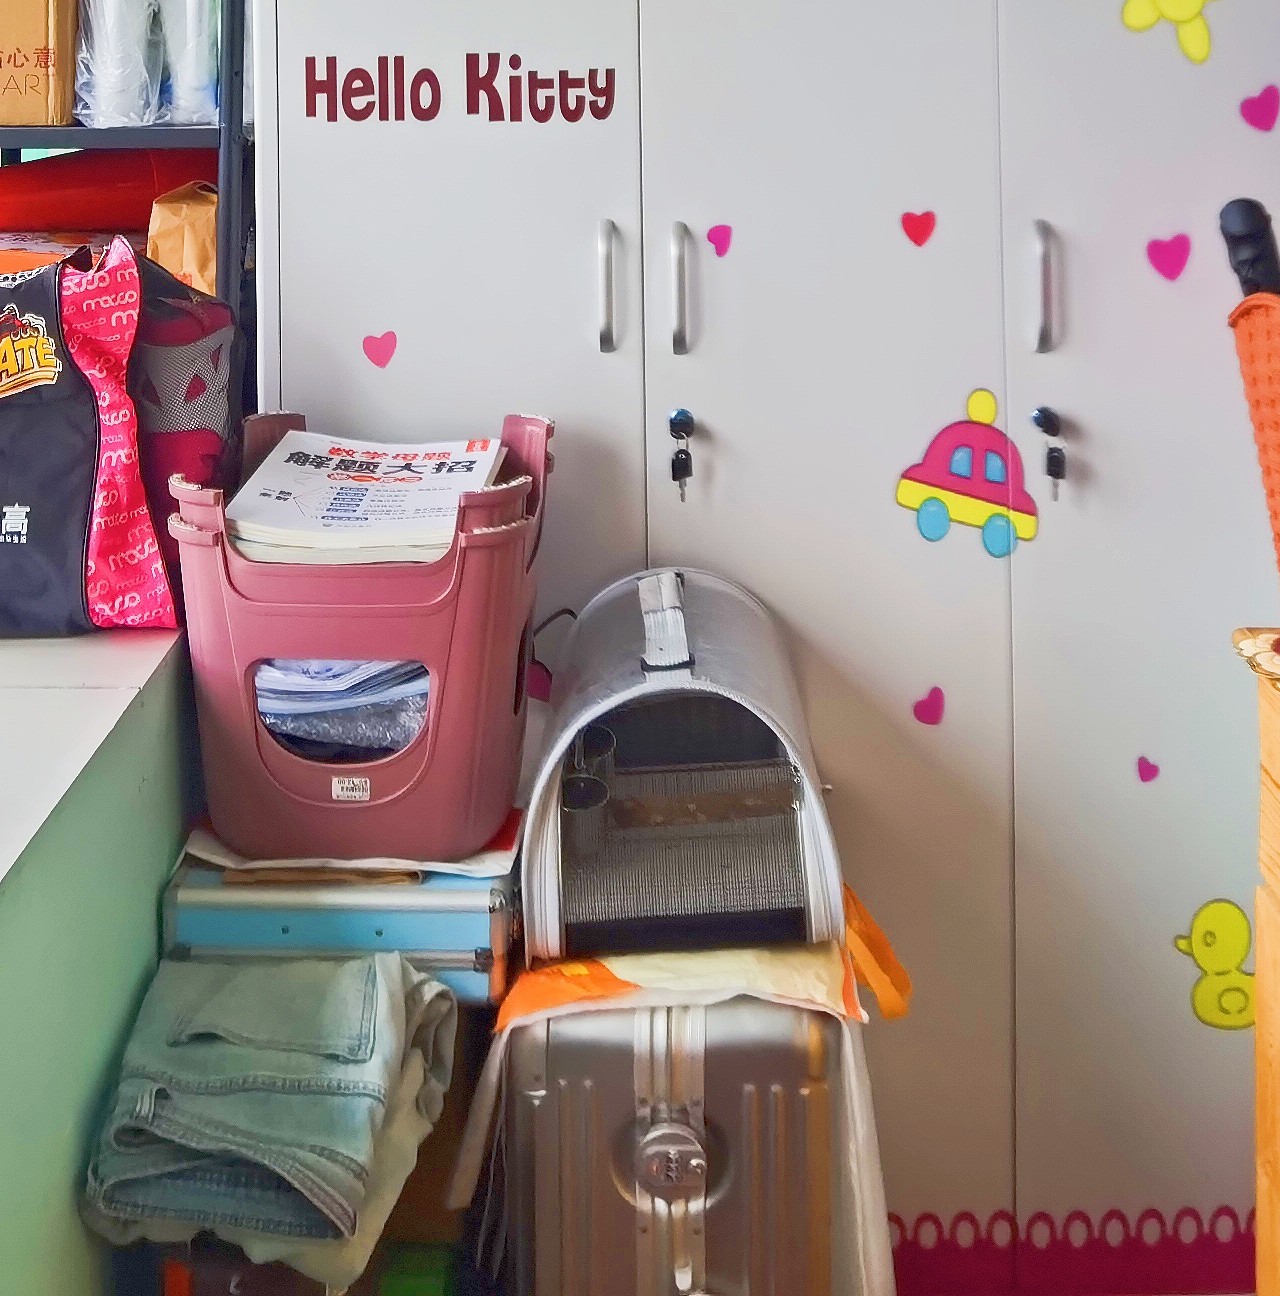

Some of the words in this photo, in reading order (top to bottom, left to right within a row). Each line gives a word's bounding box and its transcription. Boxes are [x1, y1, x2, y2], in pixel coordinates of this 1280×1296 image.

[304, 55, 442, 123] Hello
[465, 52, 616, 123] Kitty
[283, 451, 477, 475] 解题大招
